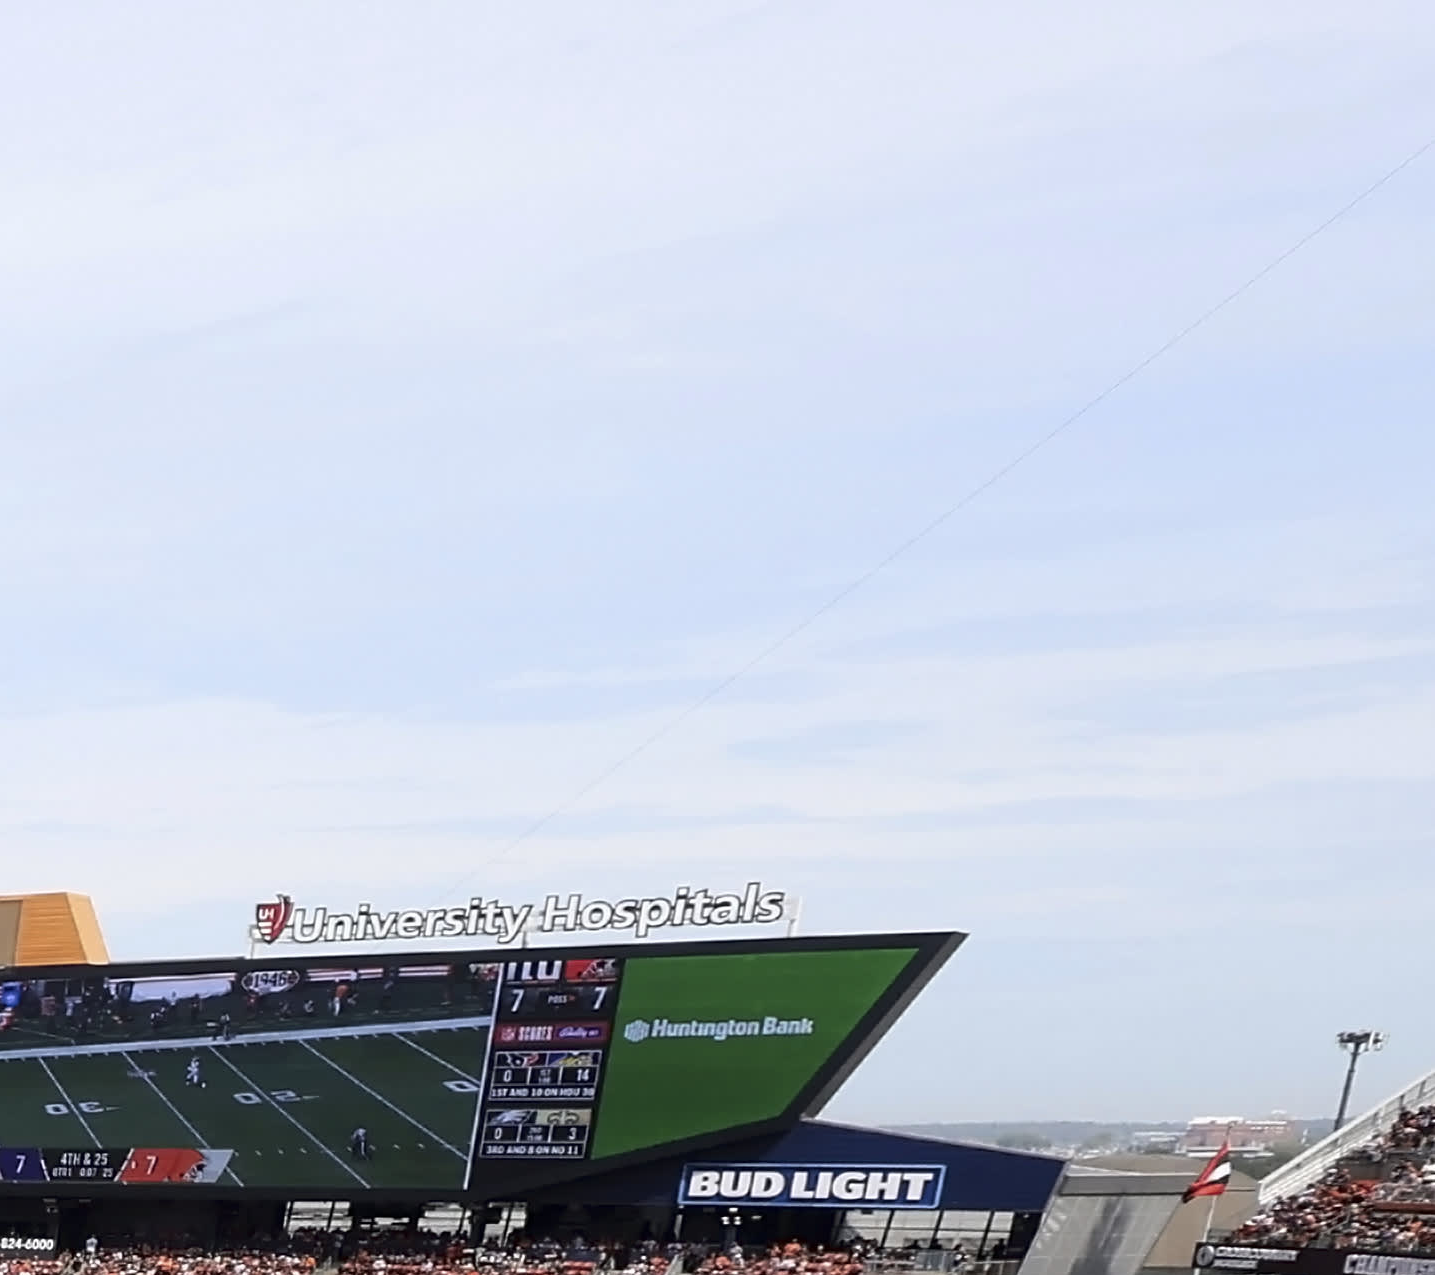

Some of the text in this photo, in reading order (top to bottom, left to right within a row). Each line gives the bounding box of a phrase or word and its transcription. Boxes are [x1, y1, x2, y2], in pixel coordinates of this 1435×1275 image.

[294, 883, 783, 944] University Hospitals
[512, 987, 607, 1012] 7 7
[651, 1017, 813, 1040] Huntington Bank
[503, 1069, 589, 1082] 0 14
[495, 1128, 577, 1140] 0 3
[16, 1156, 155, 1173] 7 7
[60, 1154, 82, 1166] 4TH
[93, 1153, 108, 1165] 25
[688, 1170, 933, 1201] BUD LIGHT
